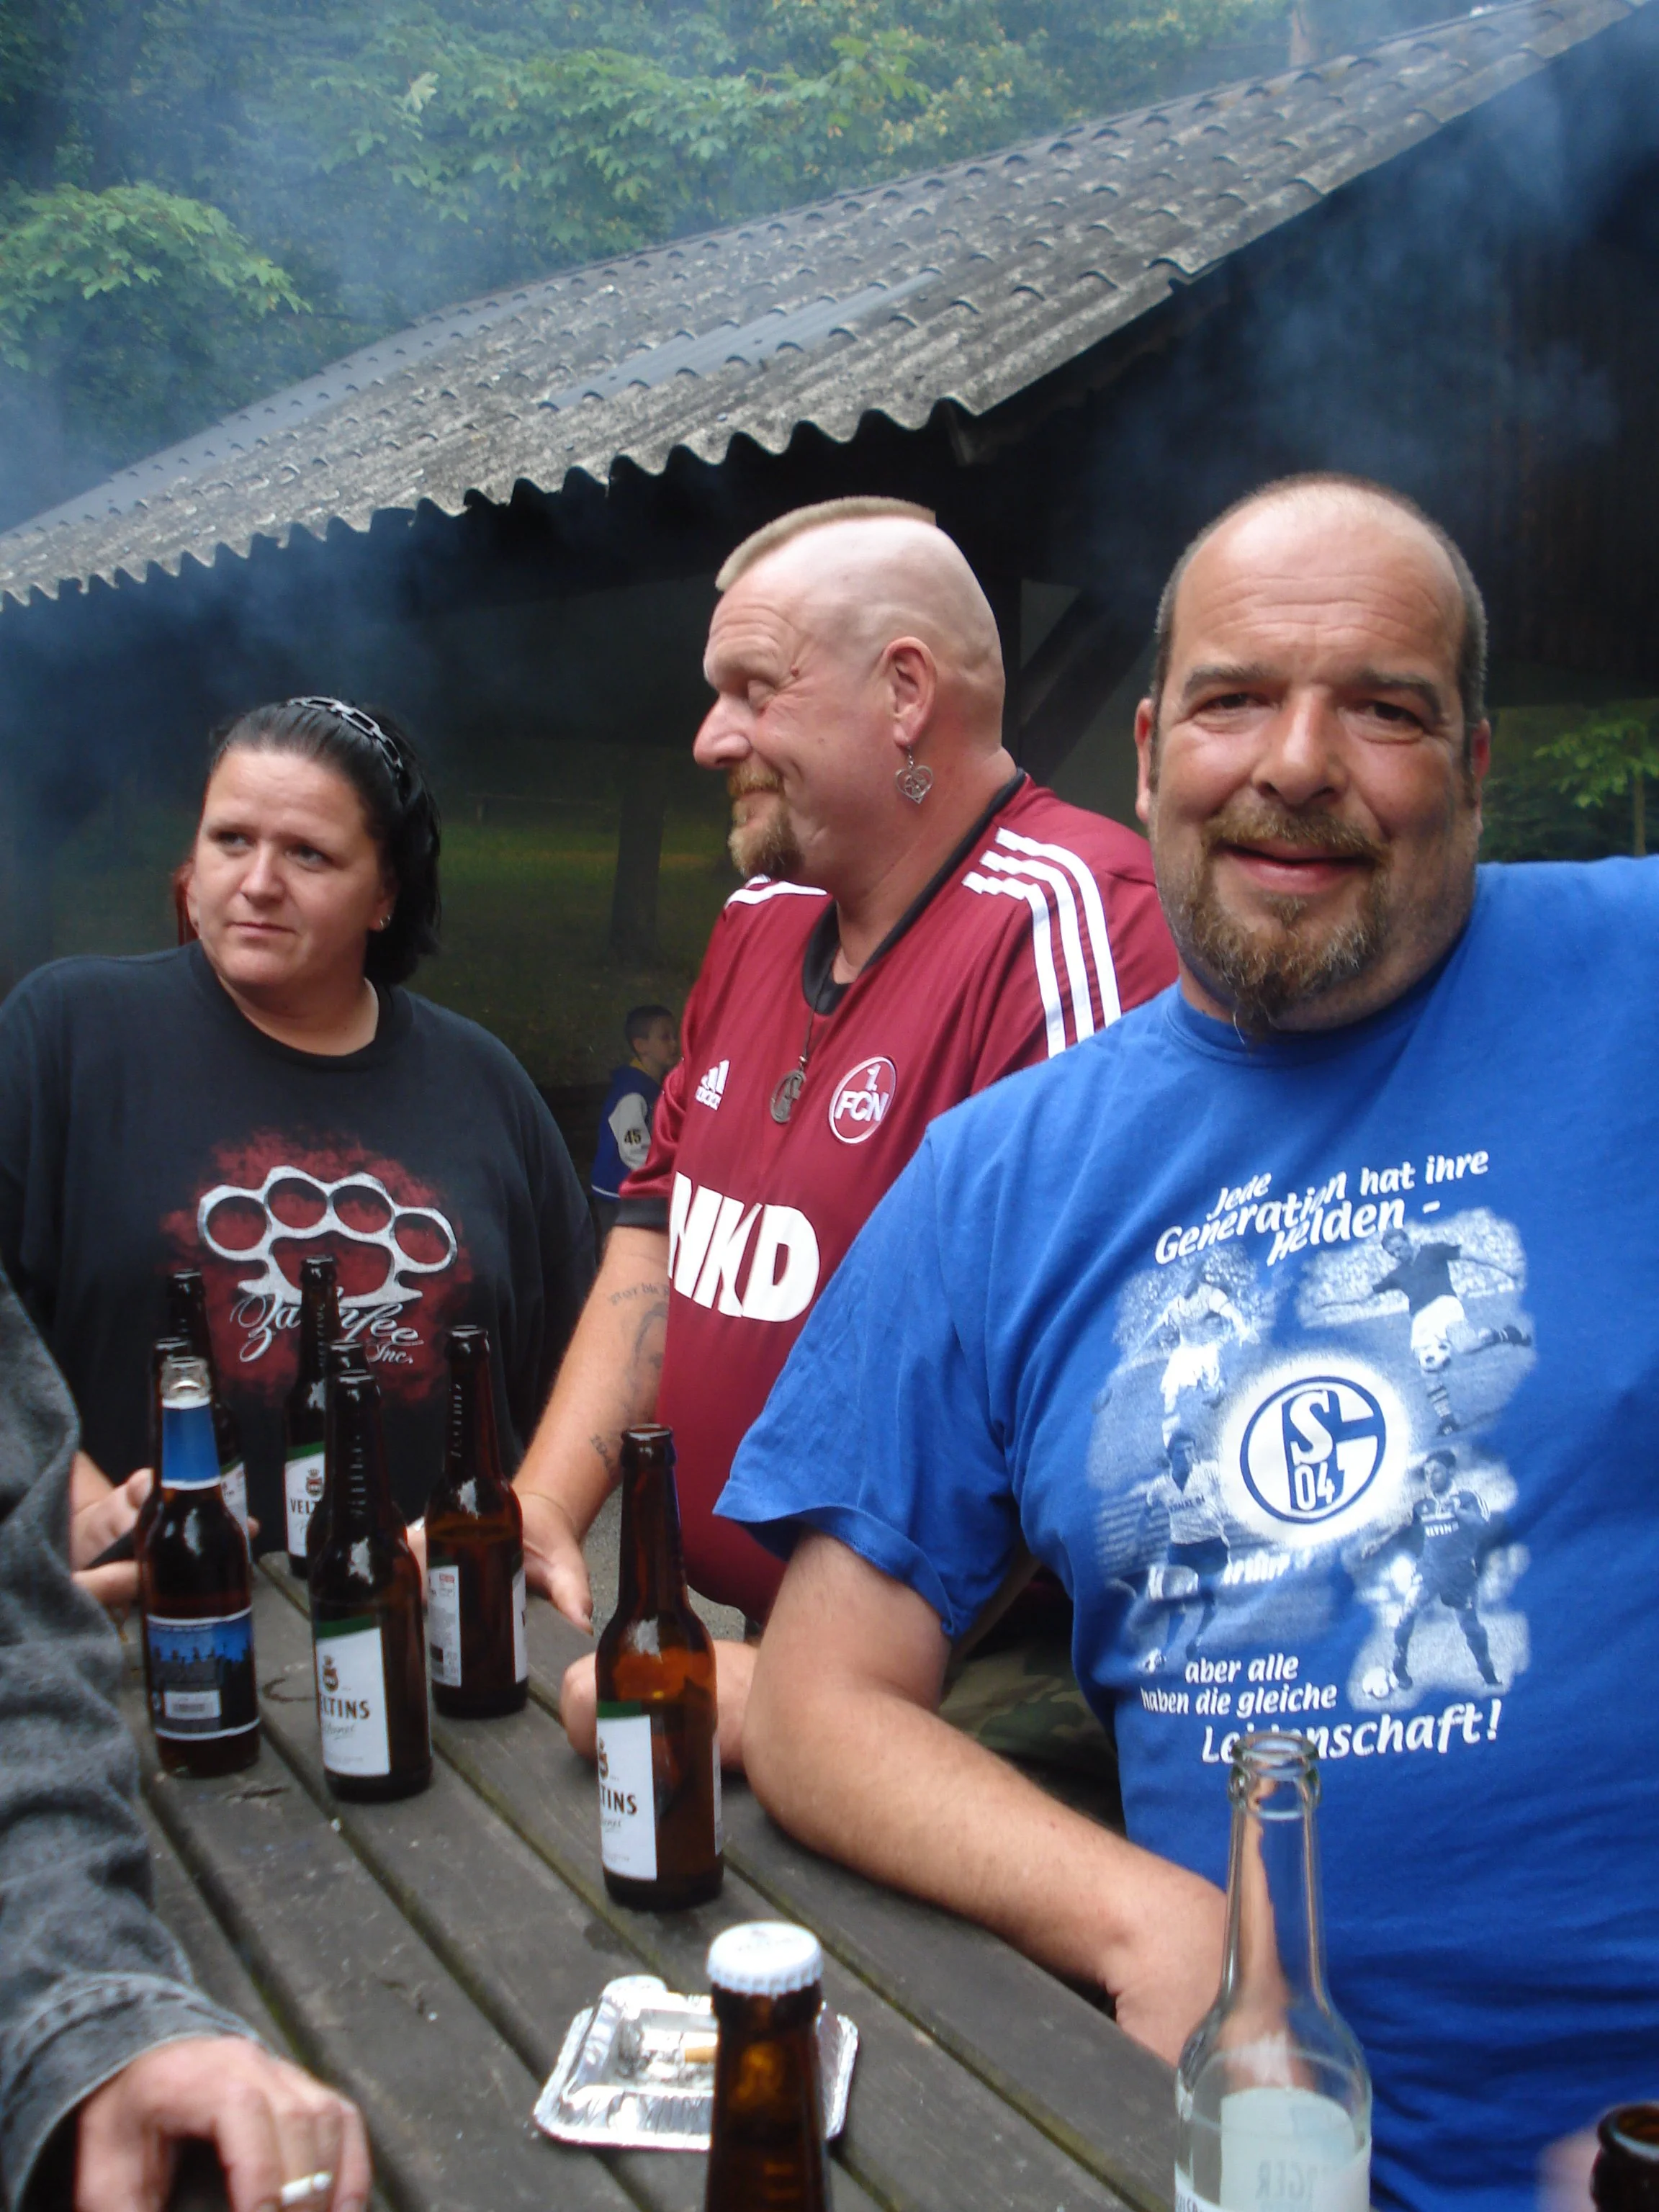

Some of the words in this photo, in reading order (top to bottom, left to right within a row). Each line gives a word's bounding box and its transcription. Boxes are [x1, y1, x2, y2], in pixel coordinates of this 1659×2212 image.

[835, 1090, 889, 1122] FCN
[624, 1128, 642, 1145] 45
[1155, 1172, 1346, 1264] Generation
[1360, 1161, 1416, 1197] hat
[1425, 1150, 1489, 1184] ihre
[1205, 1172, 1272, 1221] Jede
[667, 1171, 820, 1323] NKD
[1267, 1198, 1405, 1267] Helden
[365, 1341, 413, 1364] Inc.
[1294, 1462, 1335, 1511] 04
[1185, 1657, 1242, 1683] aber
[1248, 1653, 1299, 1683] alle
[1141, 1684, 1189, 1714] haben
[1195, 1686, 1231, 1716] die
[1236, 1681, 1337, 1719] gleiche
[1202, 1699, 1502, 1764] Lenschaft!
